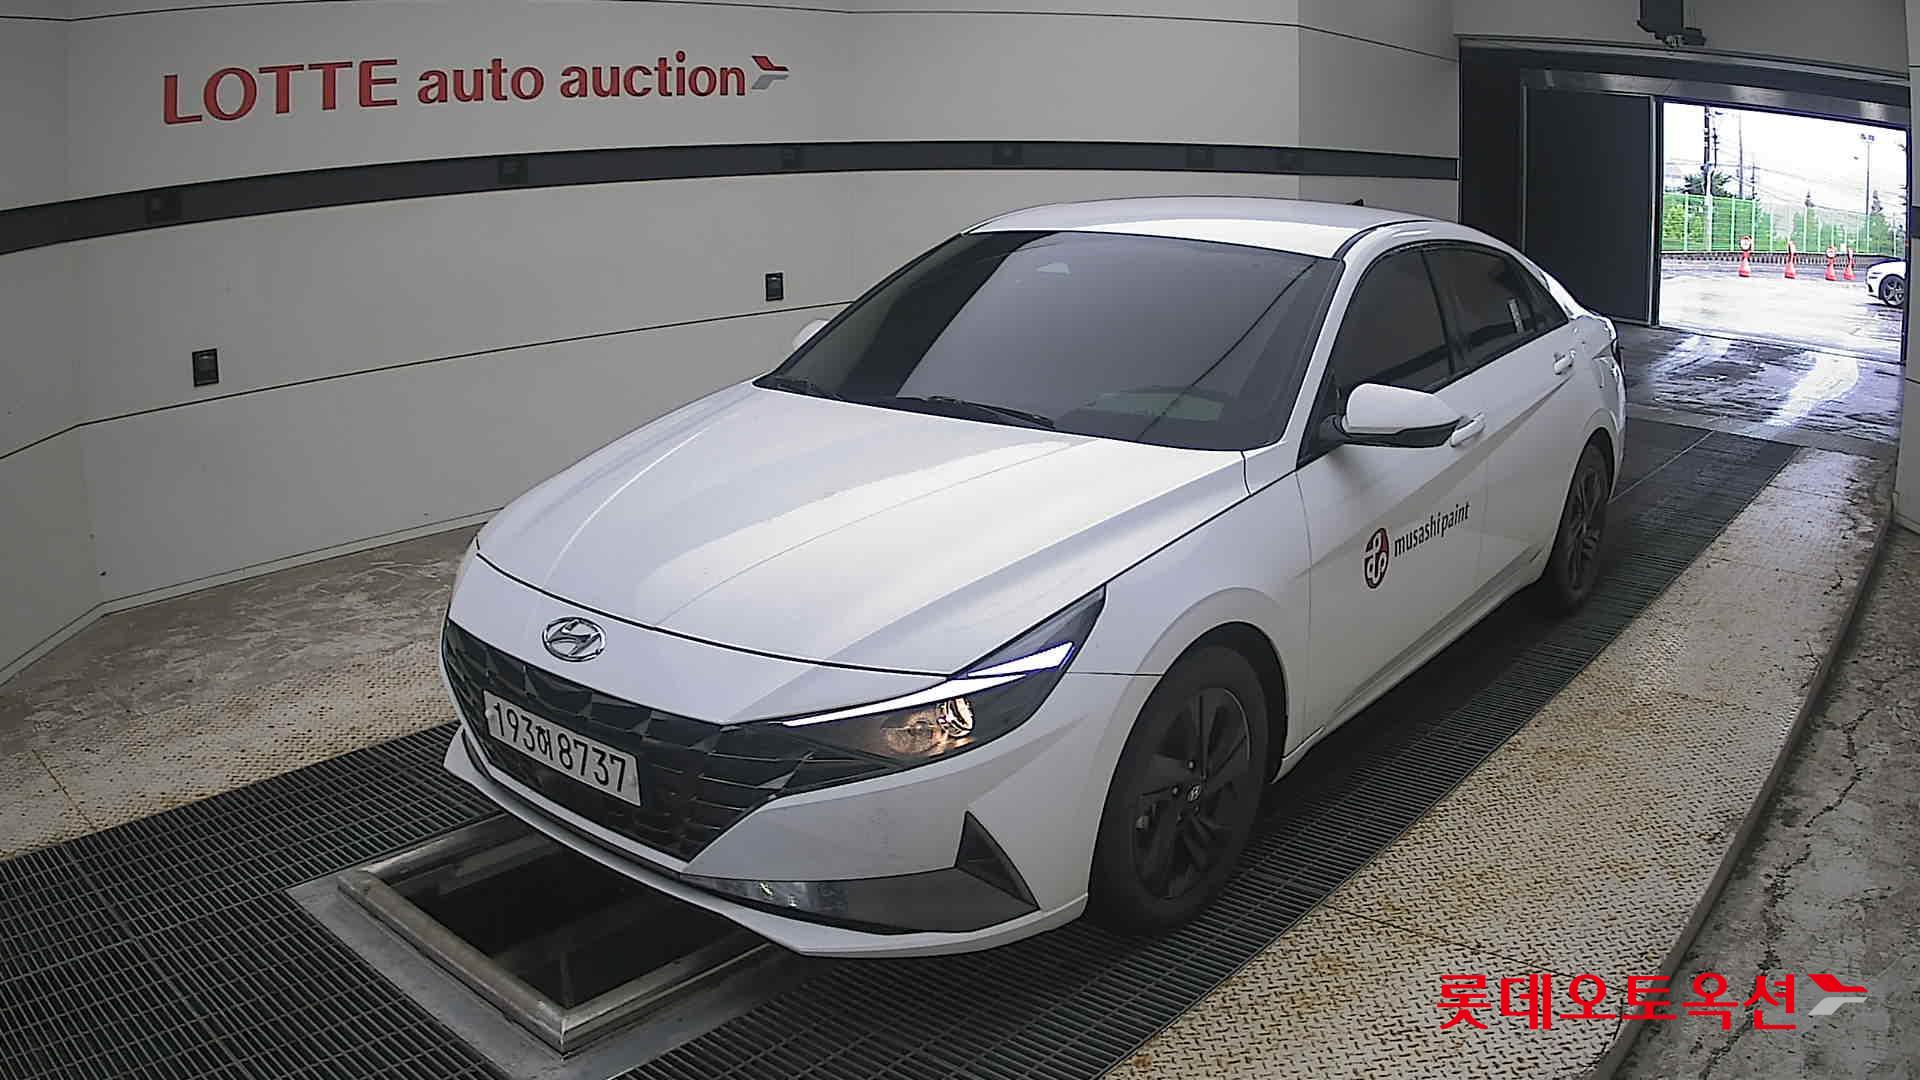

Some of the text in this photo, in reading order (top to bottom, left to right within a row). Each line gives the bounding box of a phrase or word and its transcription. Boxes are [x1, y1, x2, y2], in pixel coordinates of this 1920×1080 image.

[163, 50, 747, 125] LOTTE auto auction
